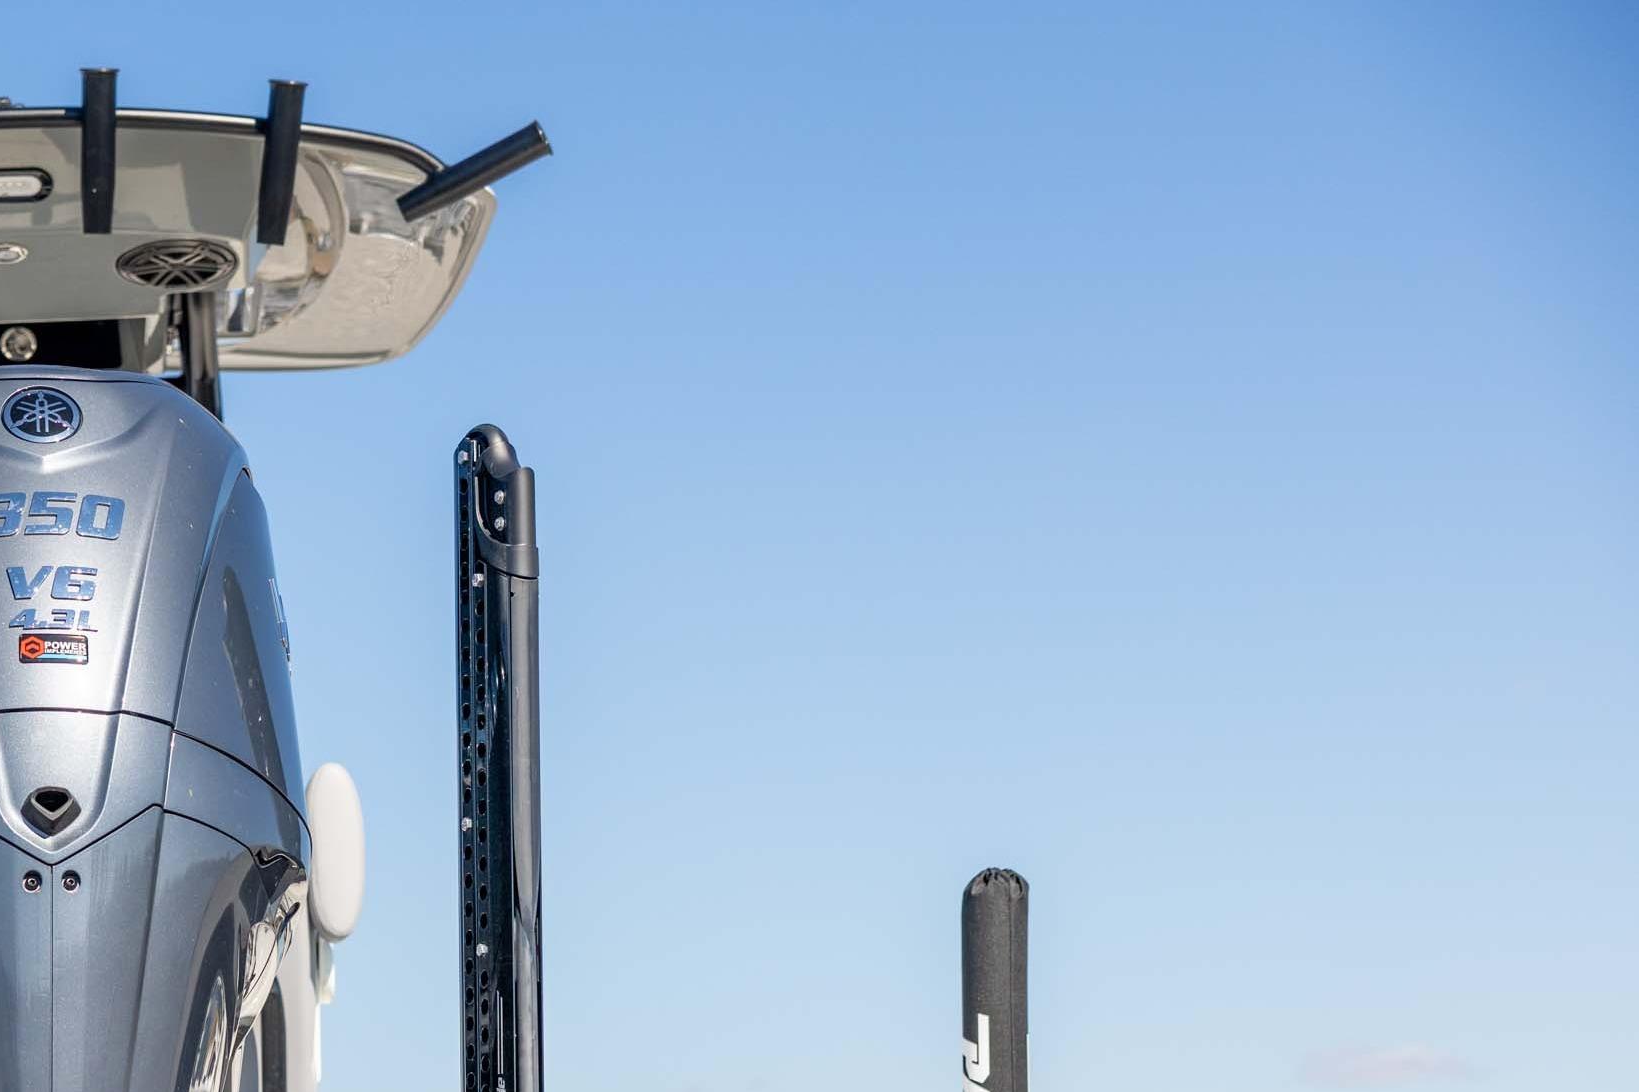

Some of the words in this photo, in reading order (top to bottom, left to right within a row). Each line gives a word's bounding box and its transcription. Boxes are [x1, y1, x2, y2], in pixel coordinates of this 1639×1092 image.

[5, 565, 98, 601] V6
[8, 608, 99, 633] 4.3L
[44, 641, 87, 652] POWER
